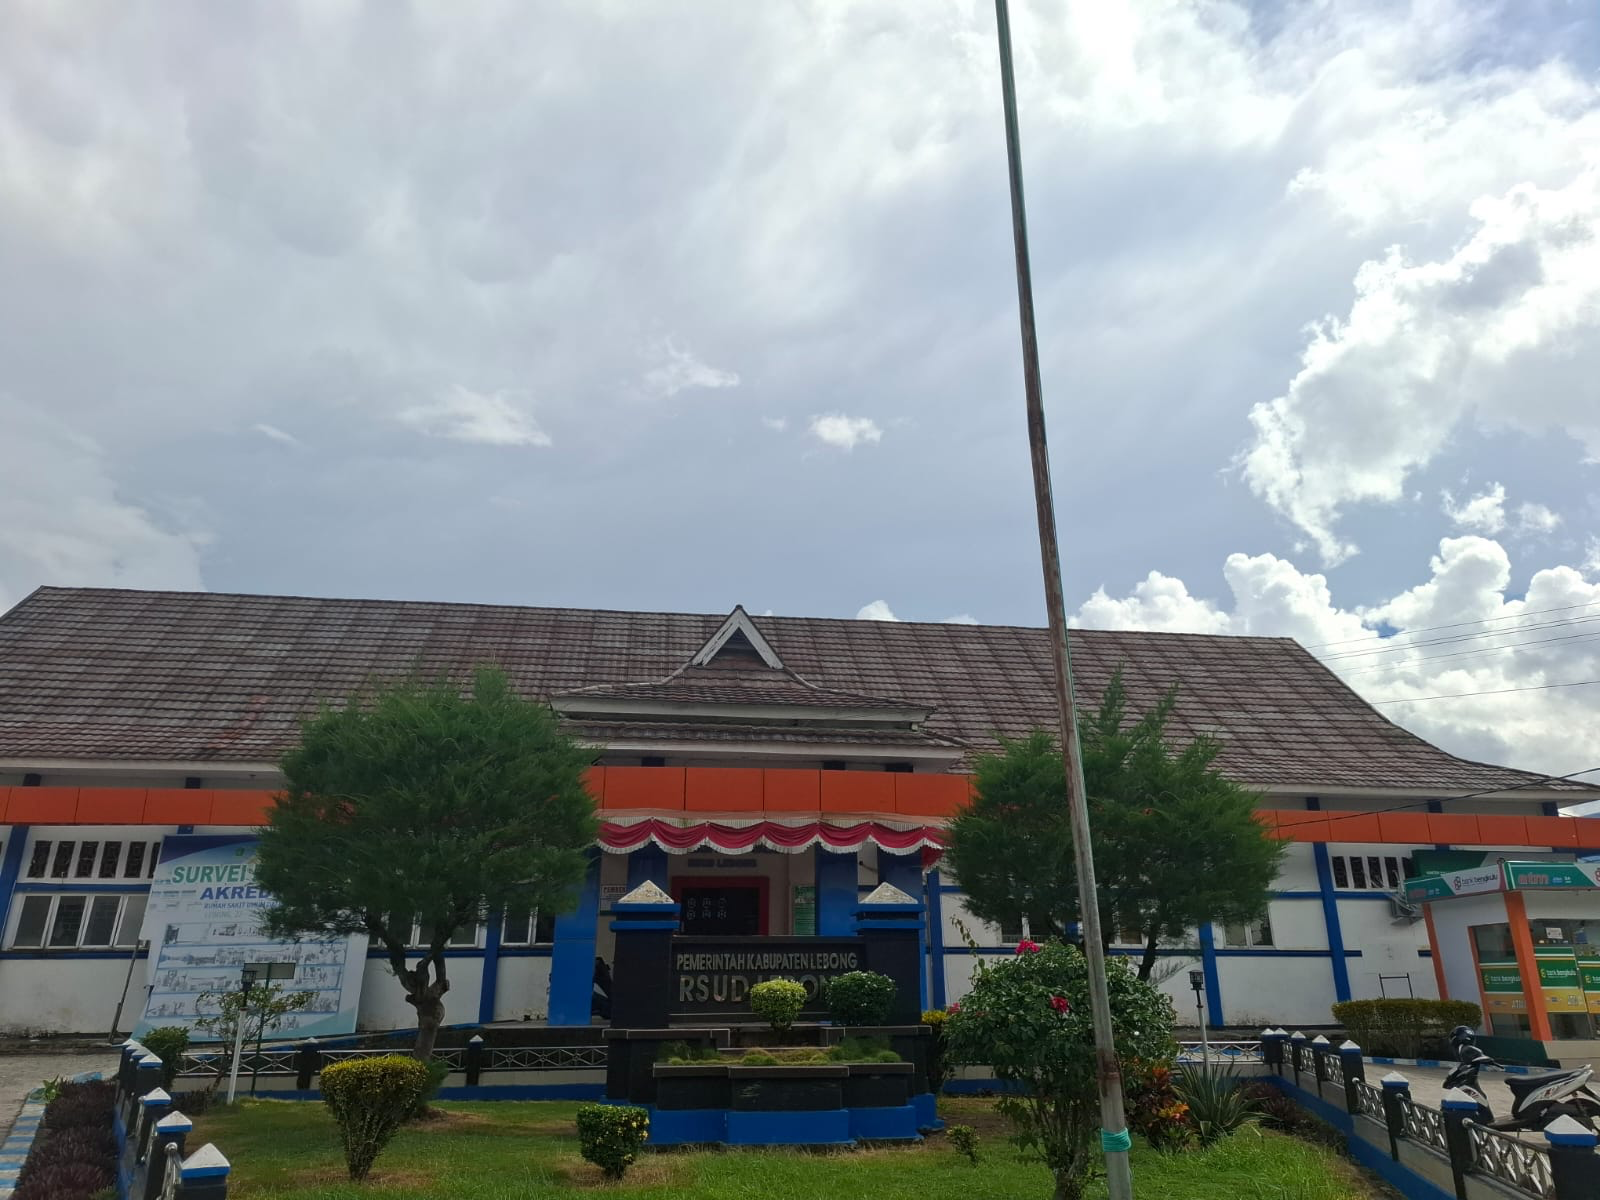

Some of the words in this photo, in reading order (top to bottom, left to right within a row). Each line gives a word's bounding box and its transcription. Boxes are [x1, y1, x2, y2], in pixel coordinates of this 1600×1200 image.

[172, 864, 248, 884] SURVEI
[200, 885, 271, 900] AKRED
[676, 953, 744, 971] PEMERINTAH
[749, 953, 809, 970] KABUPATEN
[810, 952, 857, 970] LEBONG
[679, 974, 749, 1002] RSUD
